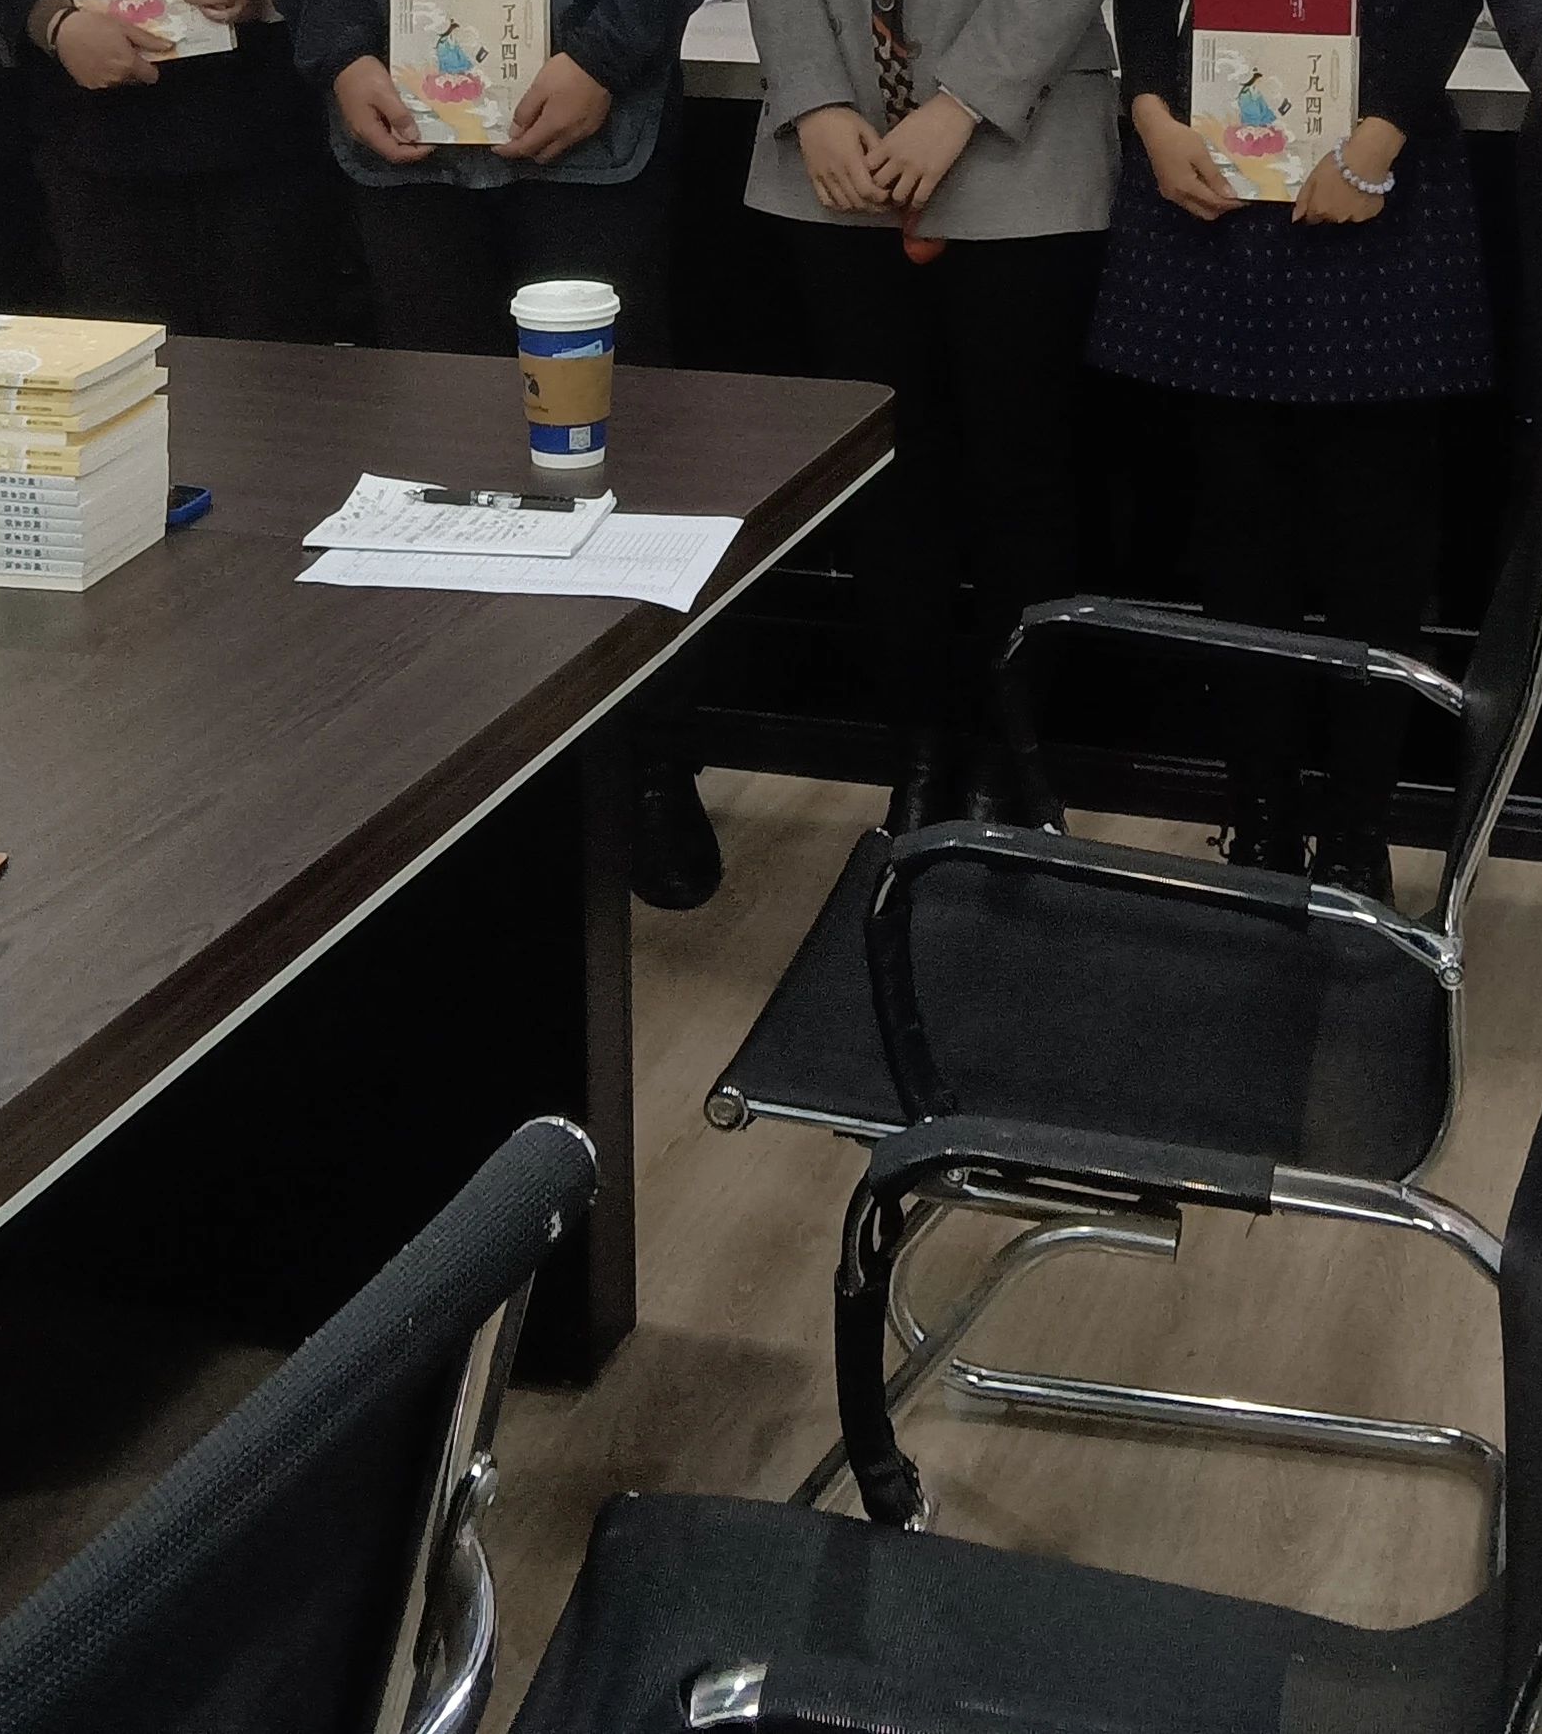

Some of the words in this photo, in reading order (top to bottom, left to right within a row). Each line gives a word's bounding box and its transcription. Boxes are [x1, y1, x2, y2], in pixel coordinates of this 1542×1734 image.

[500, 3, 519, 80] 了凡四训
[1305, 54, 1324, 136] 了凡四训
